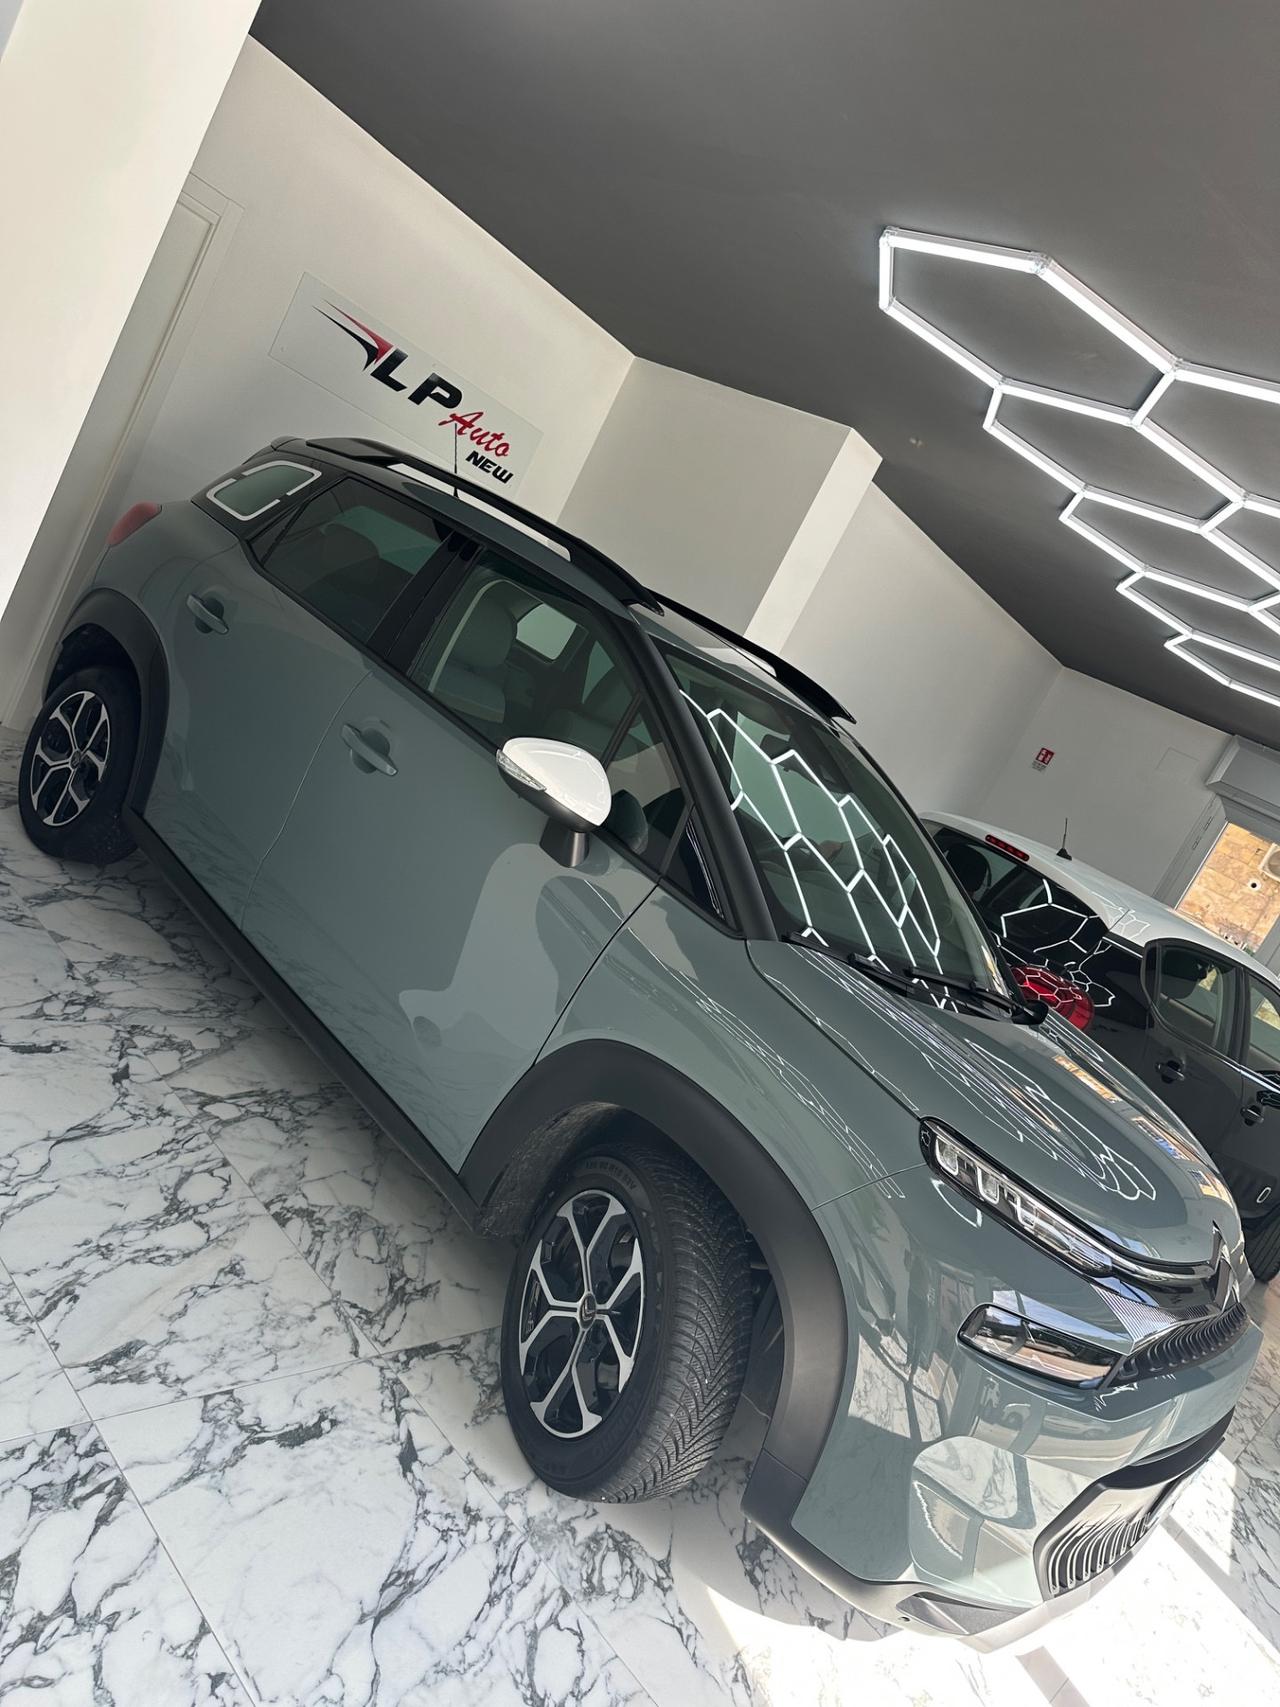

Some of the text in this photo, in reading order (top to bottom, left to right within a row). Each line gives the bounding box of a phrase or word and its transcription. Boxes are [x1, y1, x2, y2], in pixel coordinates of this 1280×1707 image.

[370, 348, 463, 409] LP
[438, 411, 510, 457] Auto
[465, 450, 514, 484] NEW
